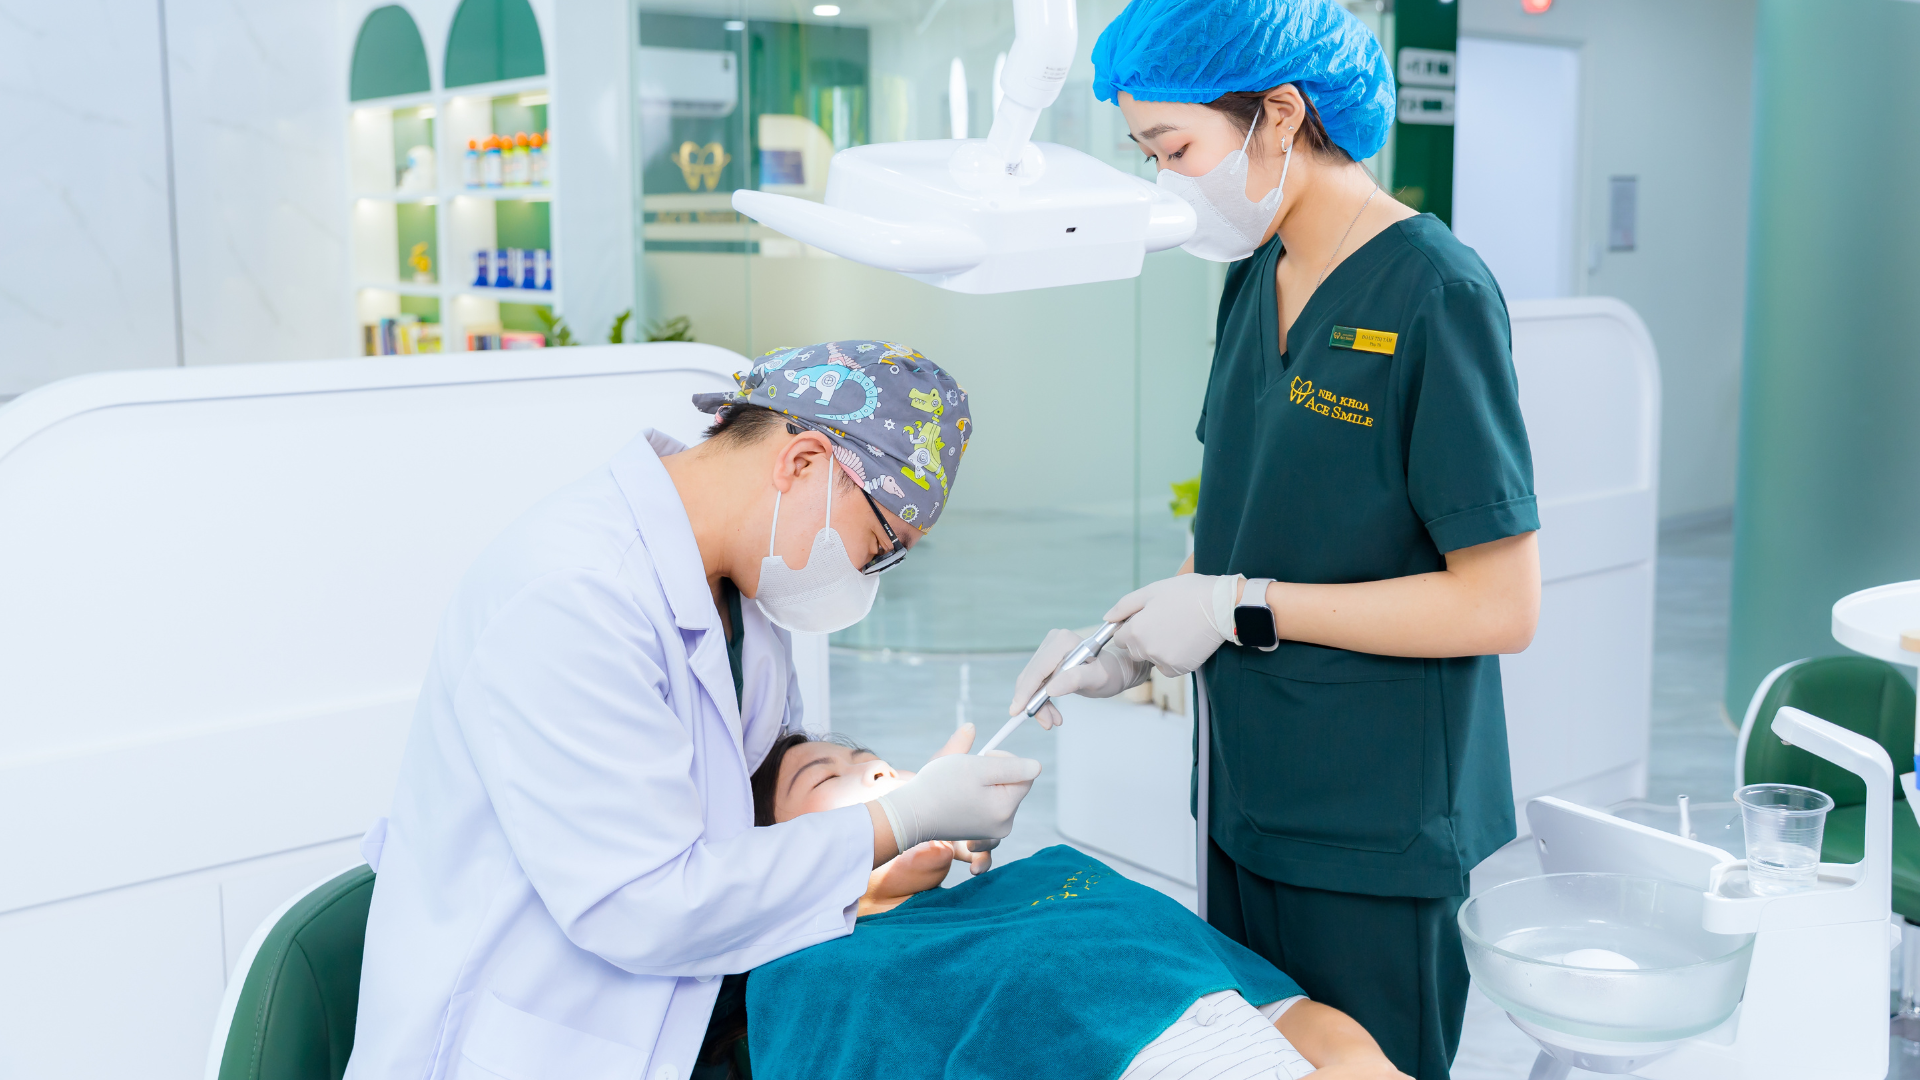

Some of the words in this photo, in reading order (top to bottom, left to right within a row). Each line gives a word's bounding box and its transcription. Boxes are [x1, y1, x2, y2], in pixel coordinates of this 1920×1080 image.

[1304, 396, 1331, 416] ACE
[1330, 405, 1374, 427] SMILE
[1318, 389, 1337, 403] NHA
[1338, 396, 1370, 411] KHOA
